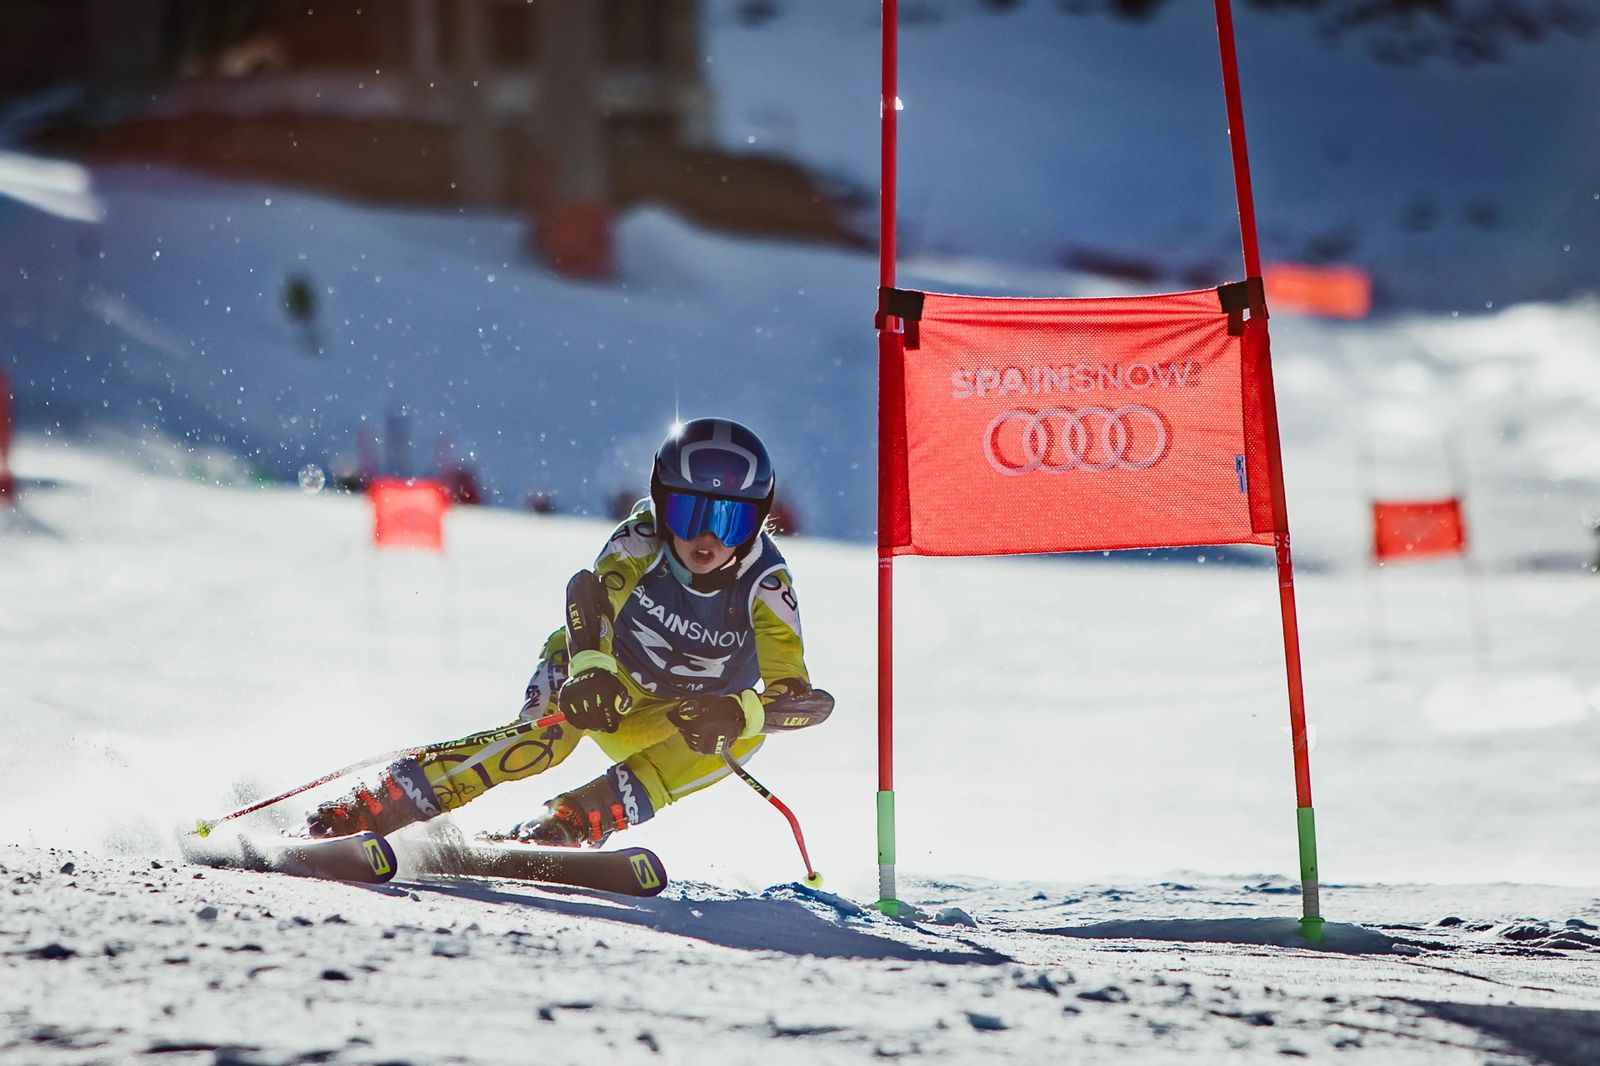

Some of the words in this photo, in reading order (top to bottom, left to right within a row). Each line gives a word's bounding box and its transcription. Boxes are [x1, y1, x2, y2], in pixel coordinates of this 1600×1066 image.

[950, 361, 1195, 398] SPAINSNOW
[569, 603, 582, 630] LEKI
[783, 717, 810, 726] LEKI
[714, 735, 725, 754] LEKI
